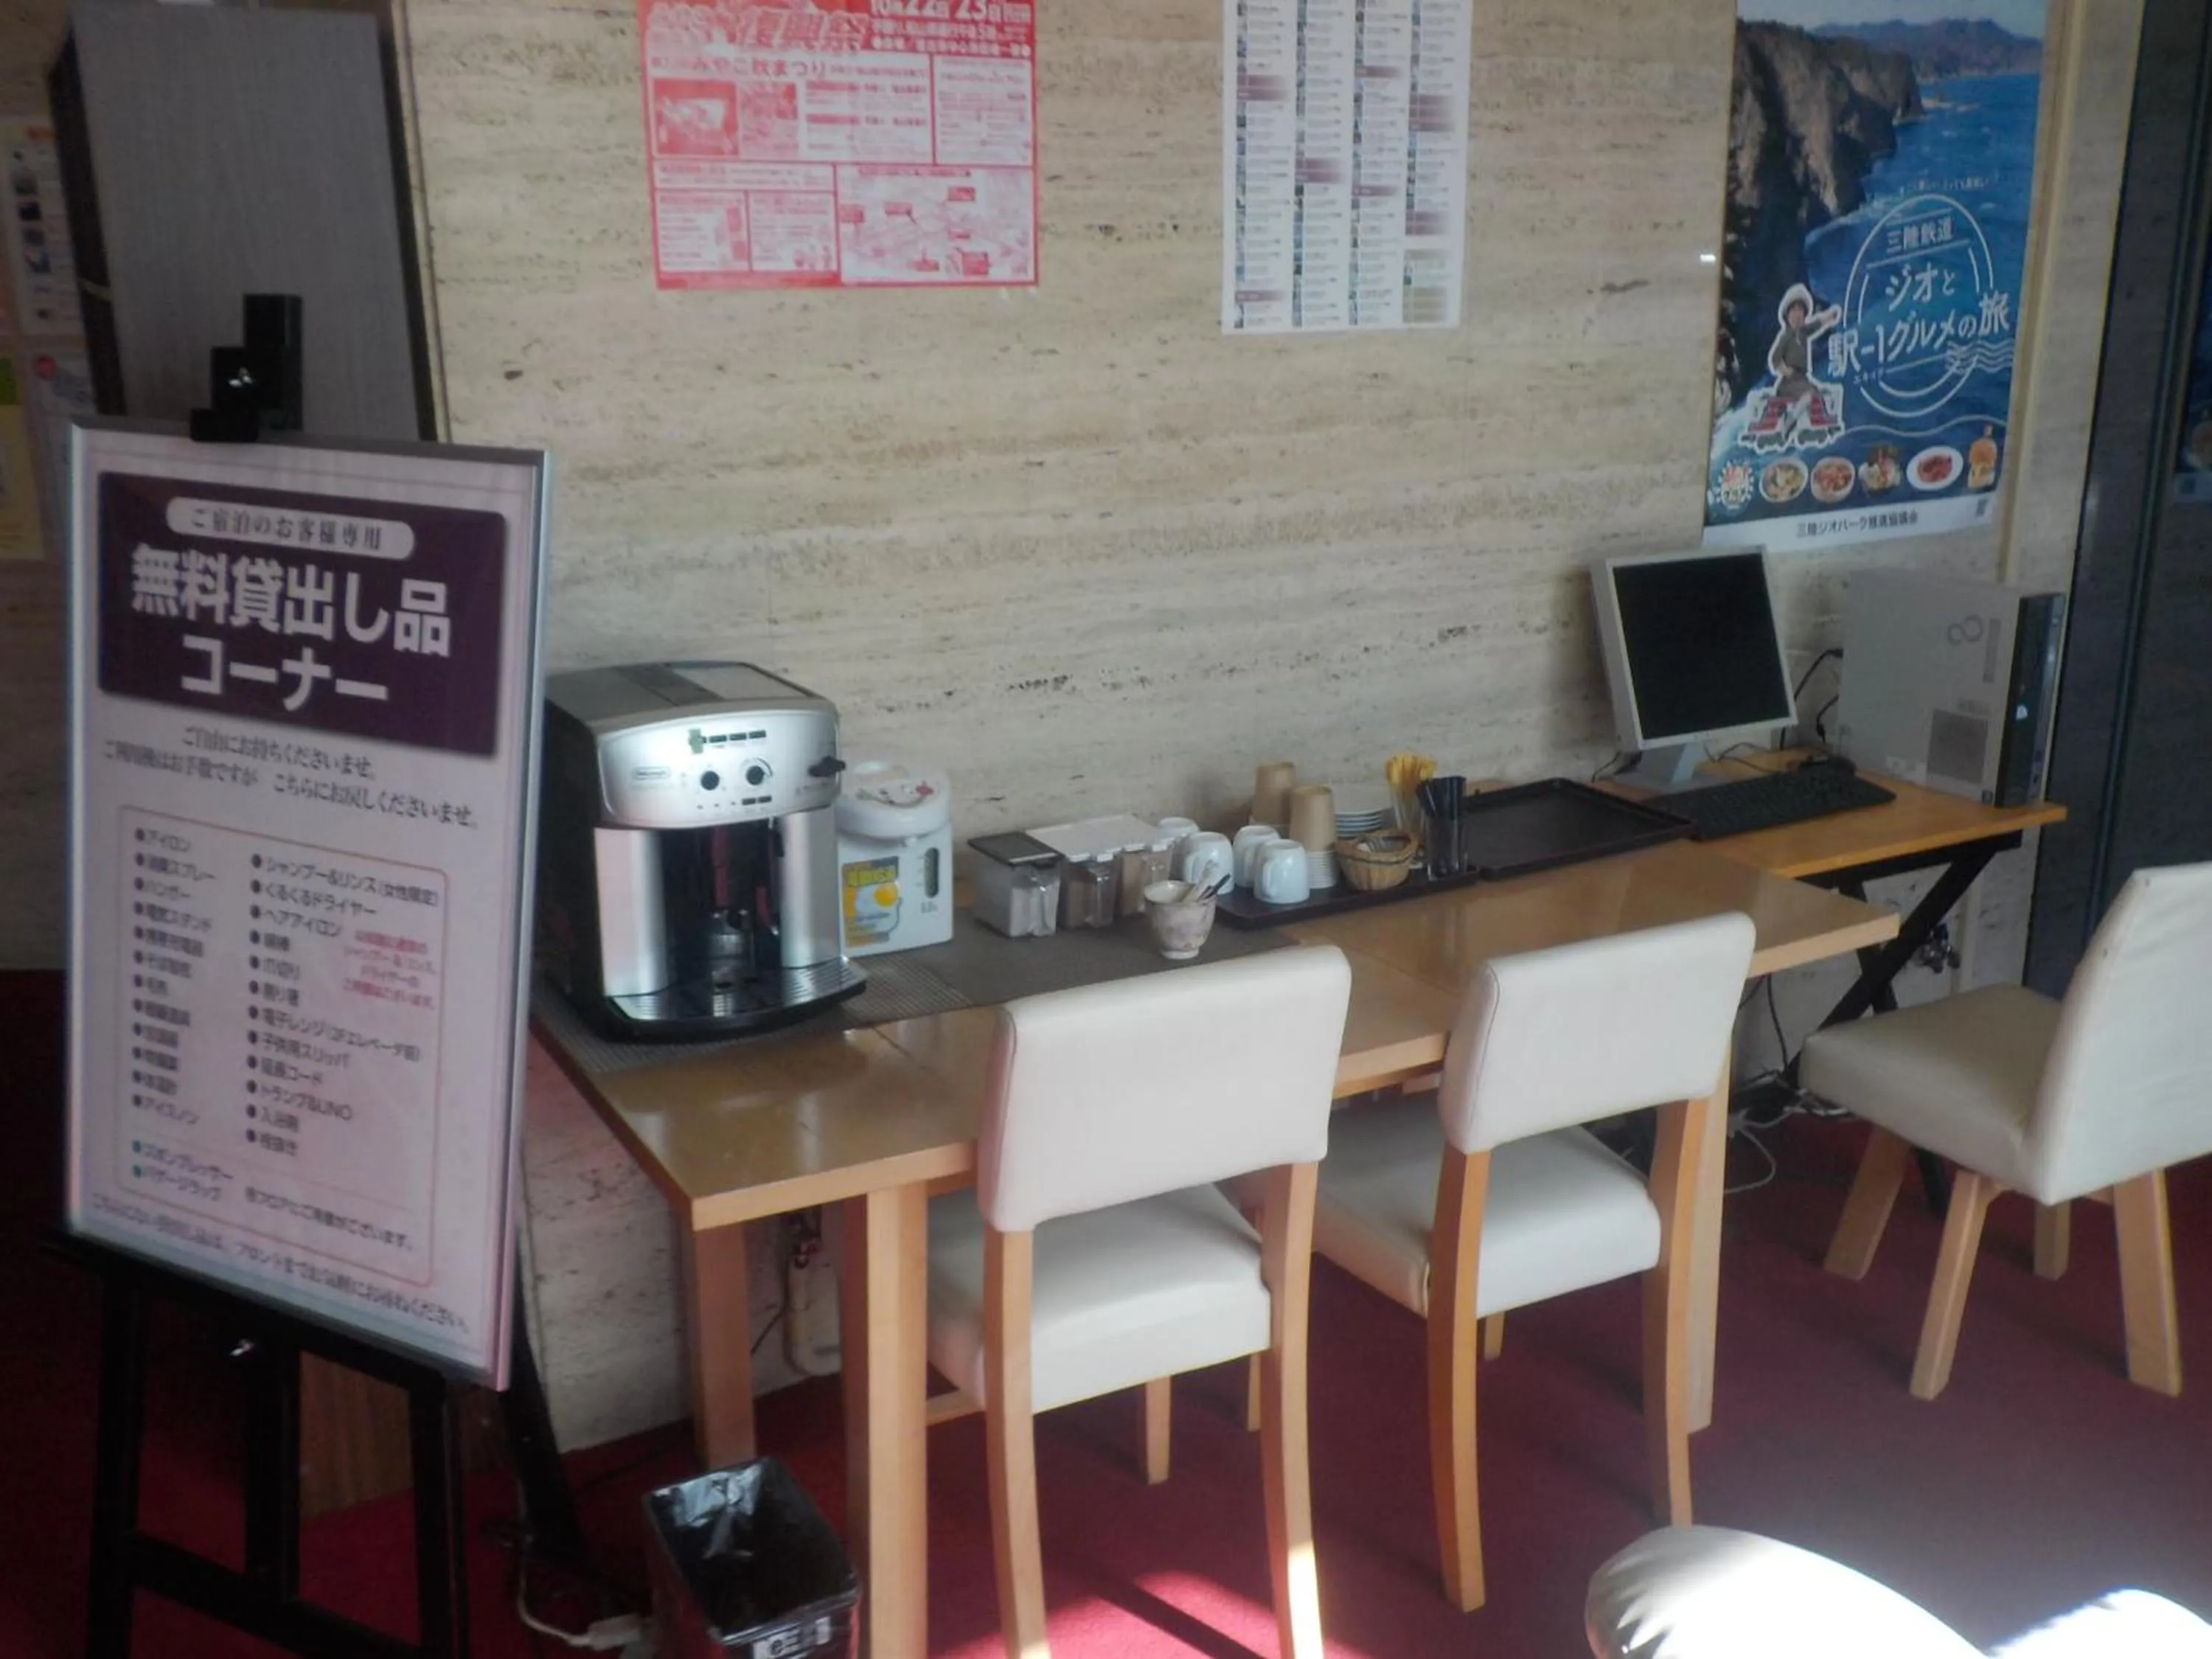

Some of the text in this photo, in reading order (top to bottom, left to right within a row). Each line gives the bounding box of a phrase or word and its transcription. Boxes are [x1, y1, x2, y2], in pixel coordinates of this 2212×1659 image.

[1886, 218, 1955, 254] 三陸鉄道
[1885, 261, 1955, 312] ジオと
[191, 506, 382, 552] ご宿泊のお客様専用
[131, 542, 451, 658] 無料貸出し品
[181, 633, 389, 712] コーナー
